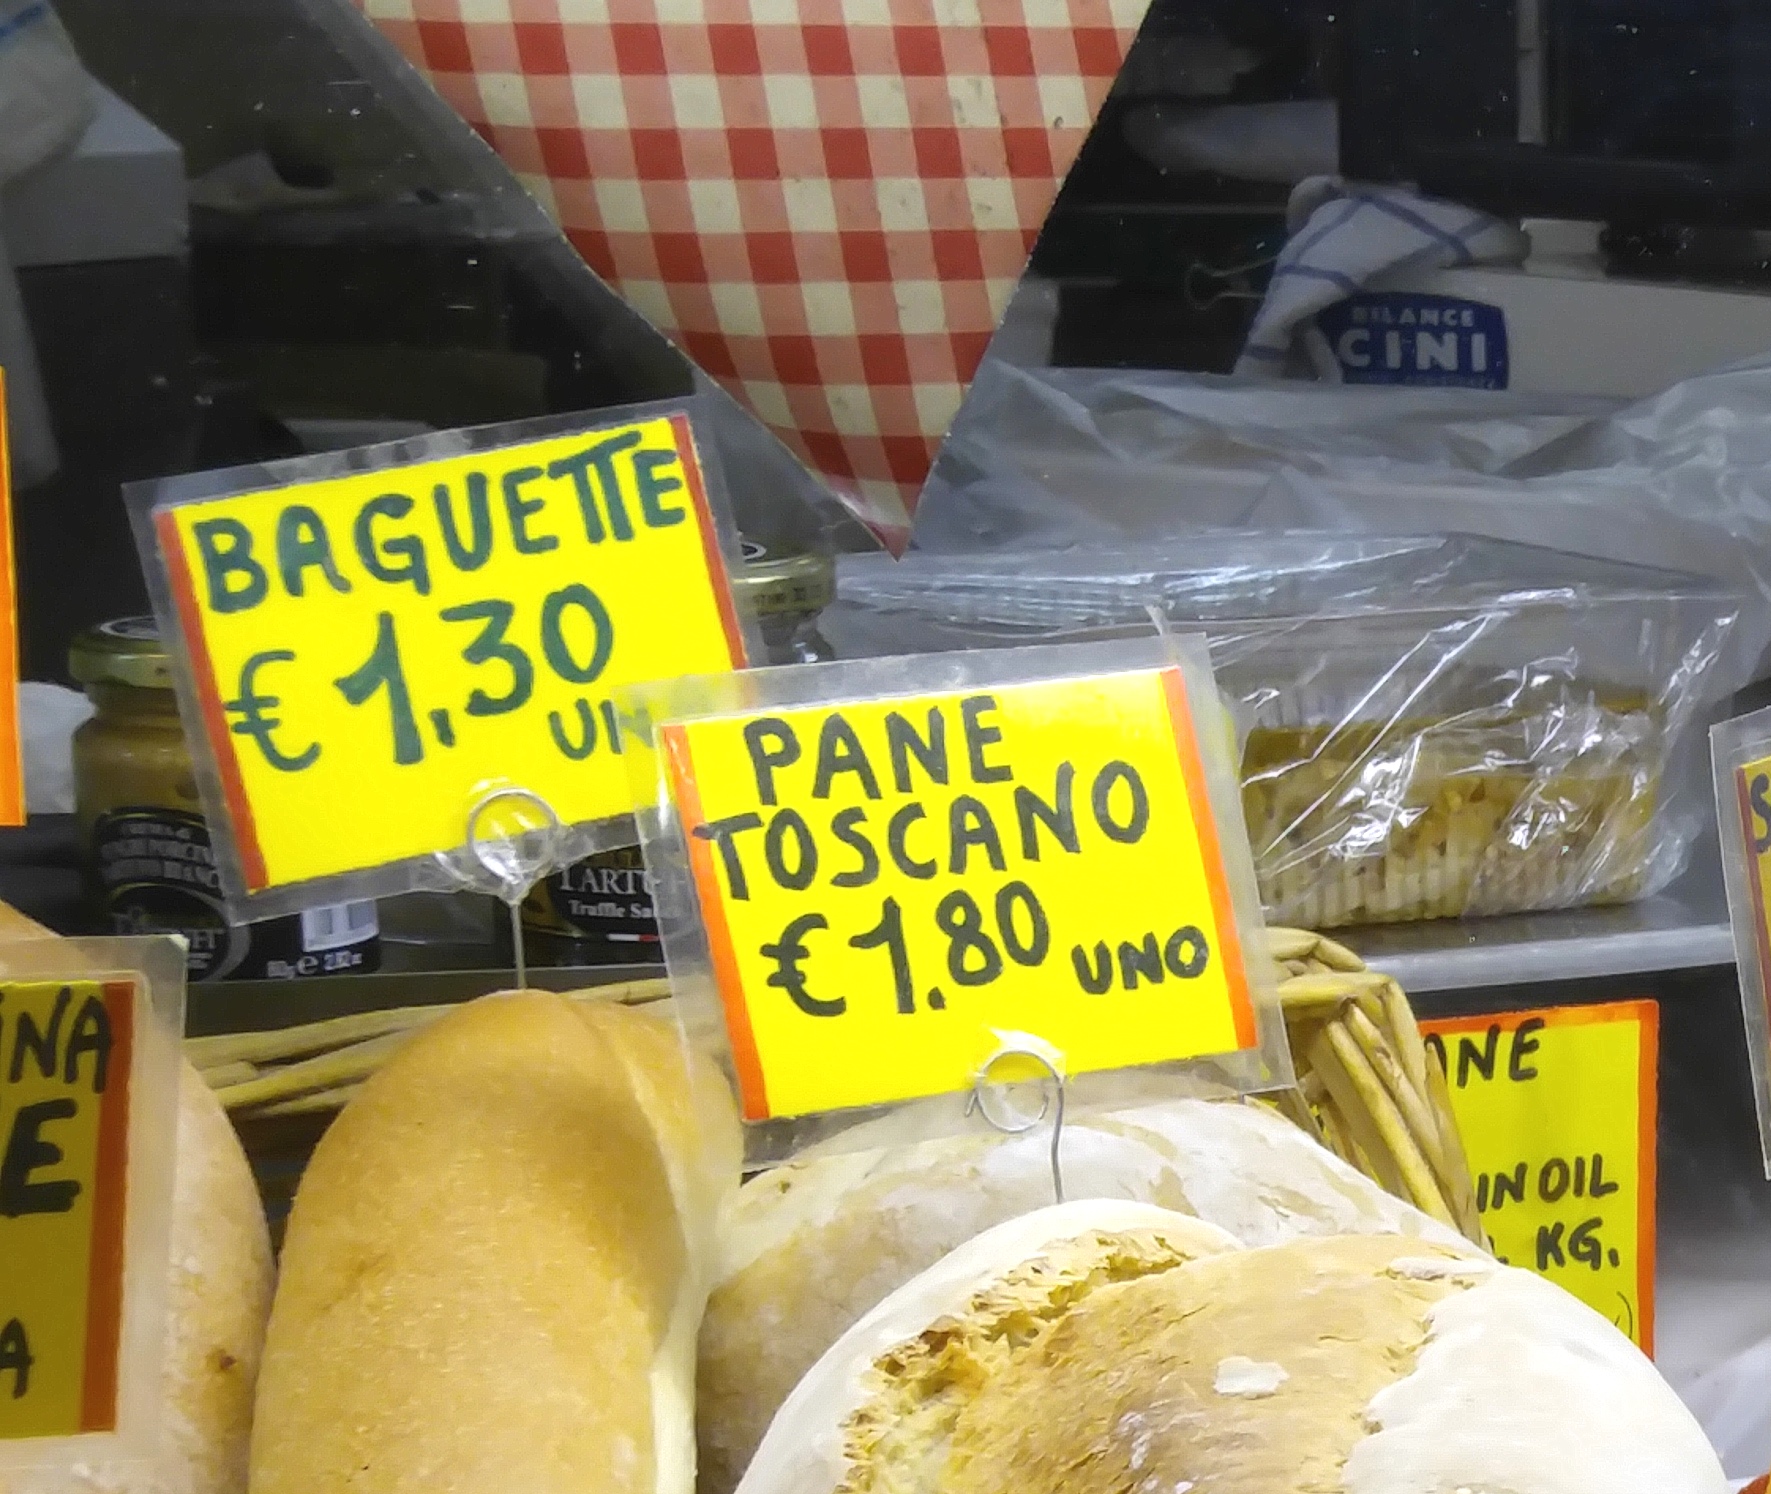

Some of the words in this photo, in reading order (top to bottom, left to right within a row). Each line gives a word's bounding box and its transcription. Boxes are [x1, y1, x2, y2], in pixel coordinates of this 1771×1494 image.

[1338, 327, 1487, 373] CINI
[193, 431, 686, 614] BAGUETTE
[743, 696, 1012, 805] PANE
[693, 760, 1149, 900] TOSCANO
[1071, 925, 1209, 995] UNO
[1537, 1152, 1620, 1202] OIL
[1535, 1216, 1621, 1272] KG.
